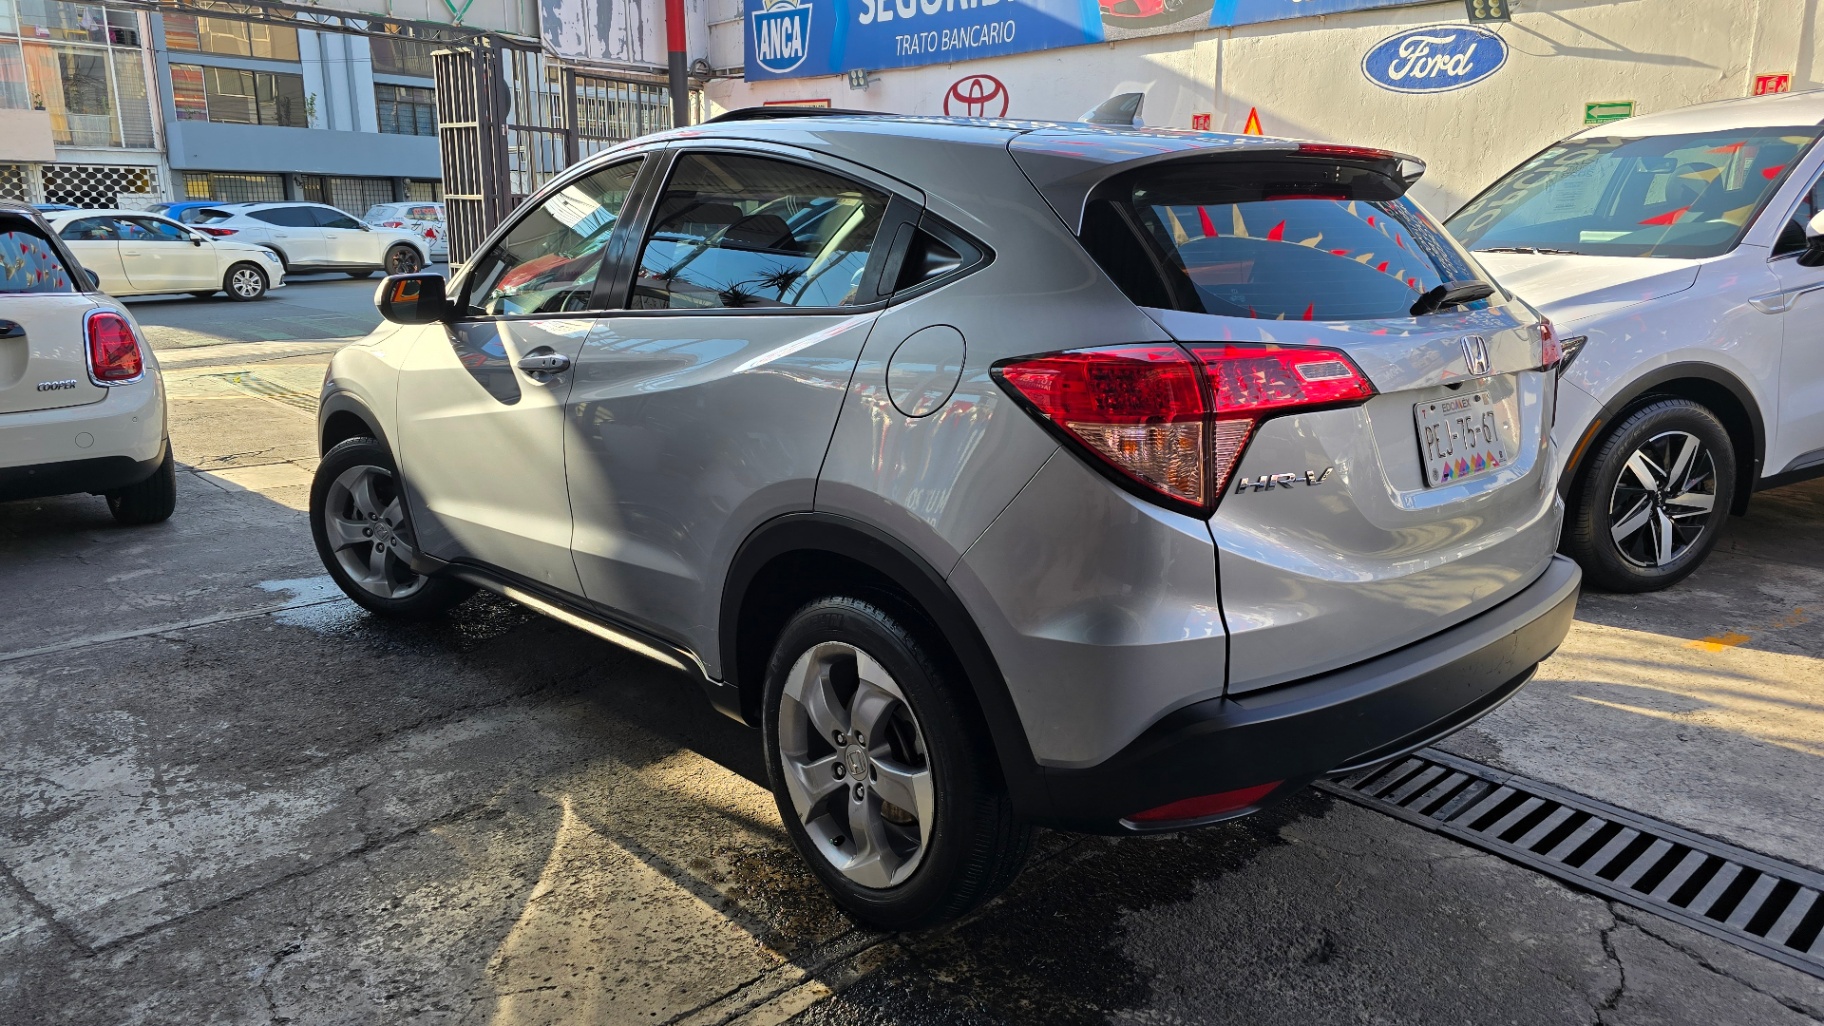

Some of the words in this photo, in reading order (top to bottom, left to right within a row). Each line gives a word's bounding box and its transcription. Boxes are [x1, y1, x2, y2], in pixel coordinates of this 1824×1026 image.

[760, 15, 803, 60] ANCA
[895, 31, 938, 56] TRATO
[941, 20, 1016, 51] BANCARIO
[1388, 34, 1478, 80] Ford
[37, 379, 77, 392] COOPER
[1425, 410, 1498, 461] PEJ-75-67
[1234, 466, 1334, 494] HR-V
